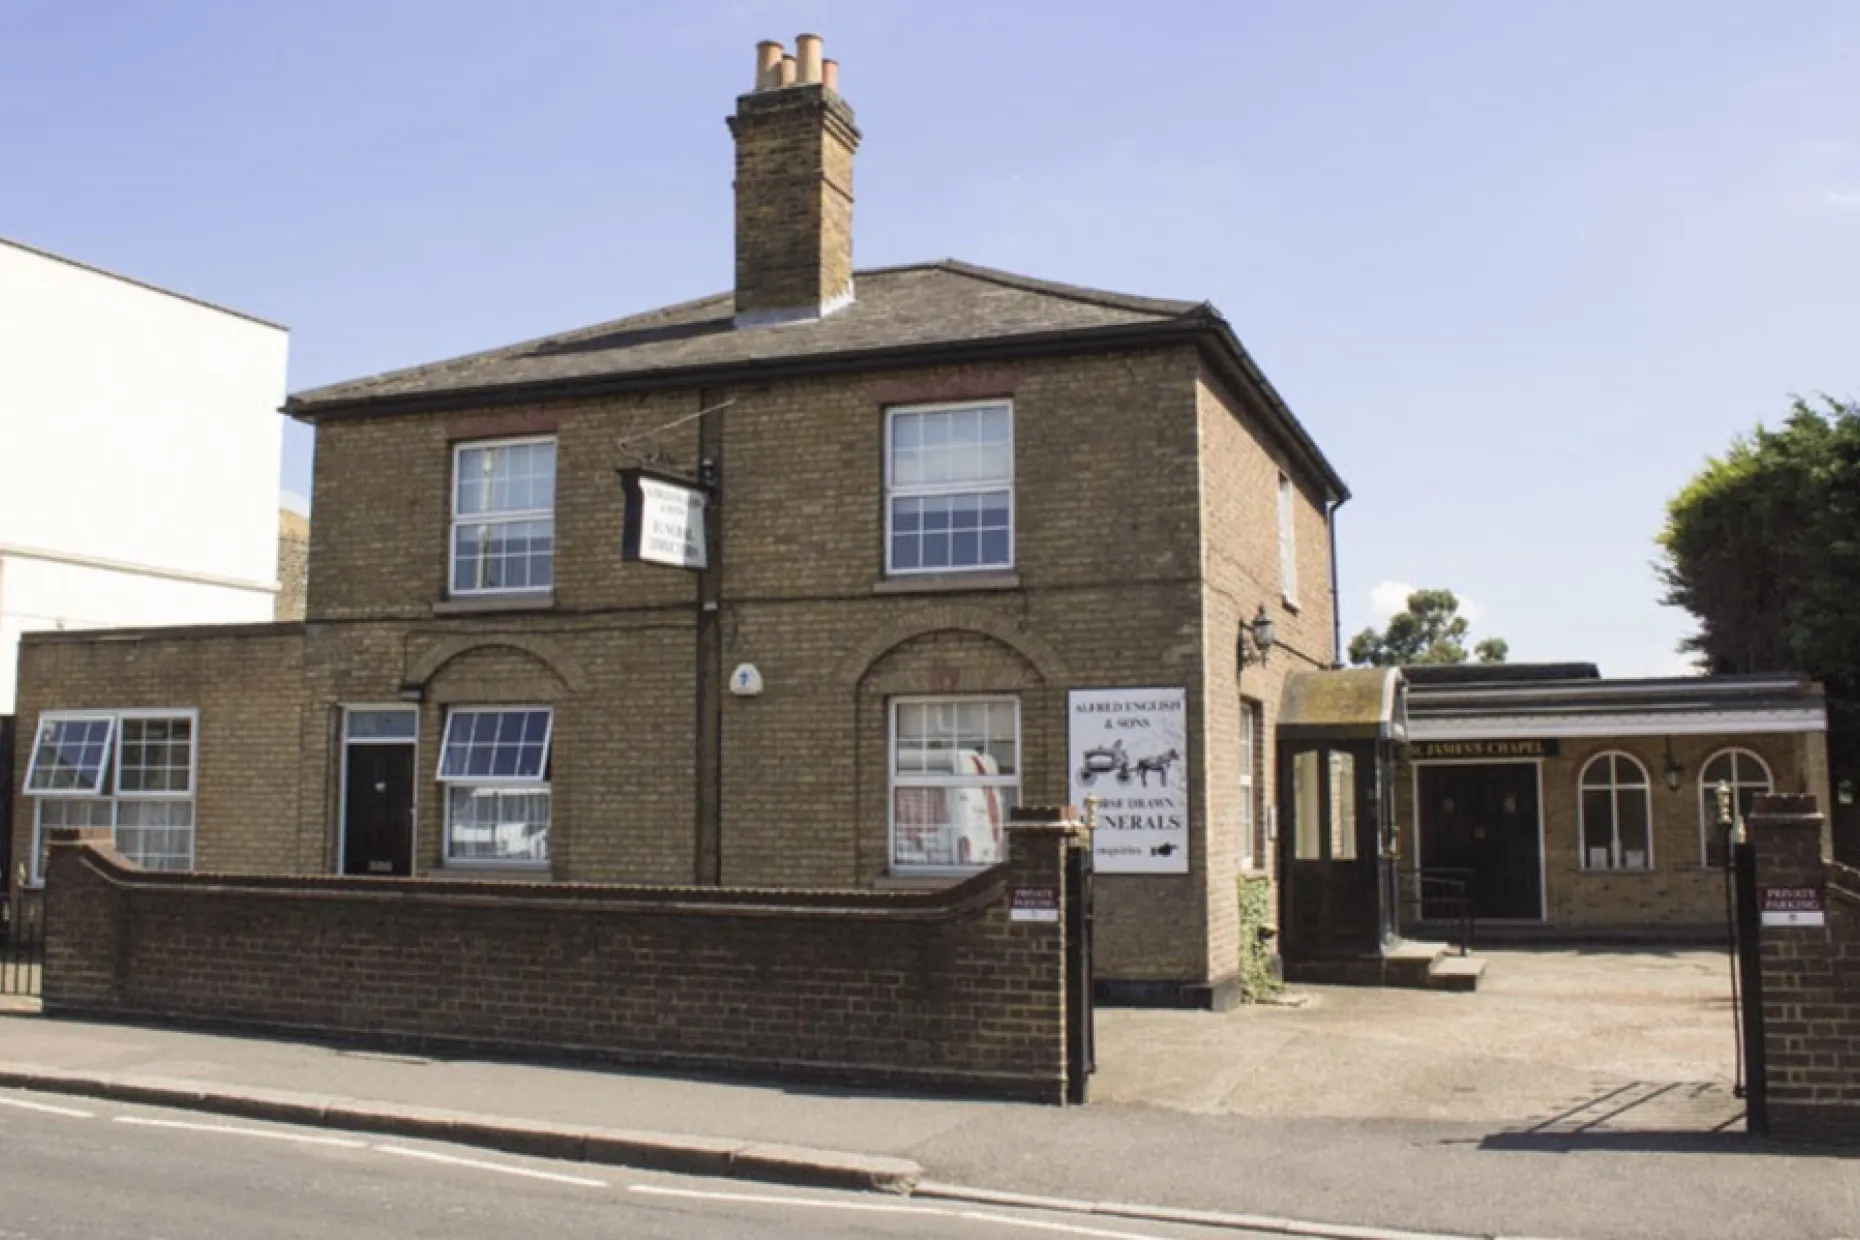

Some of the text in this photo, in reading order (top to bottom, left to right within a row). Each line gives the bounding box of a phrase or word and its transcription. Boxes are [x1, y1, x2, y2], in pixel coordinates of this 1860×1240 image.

[1075, 700, 1181, 713] ALFRED ENGLISH
[1079, 815, 1182, 830] NERALS
